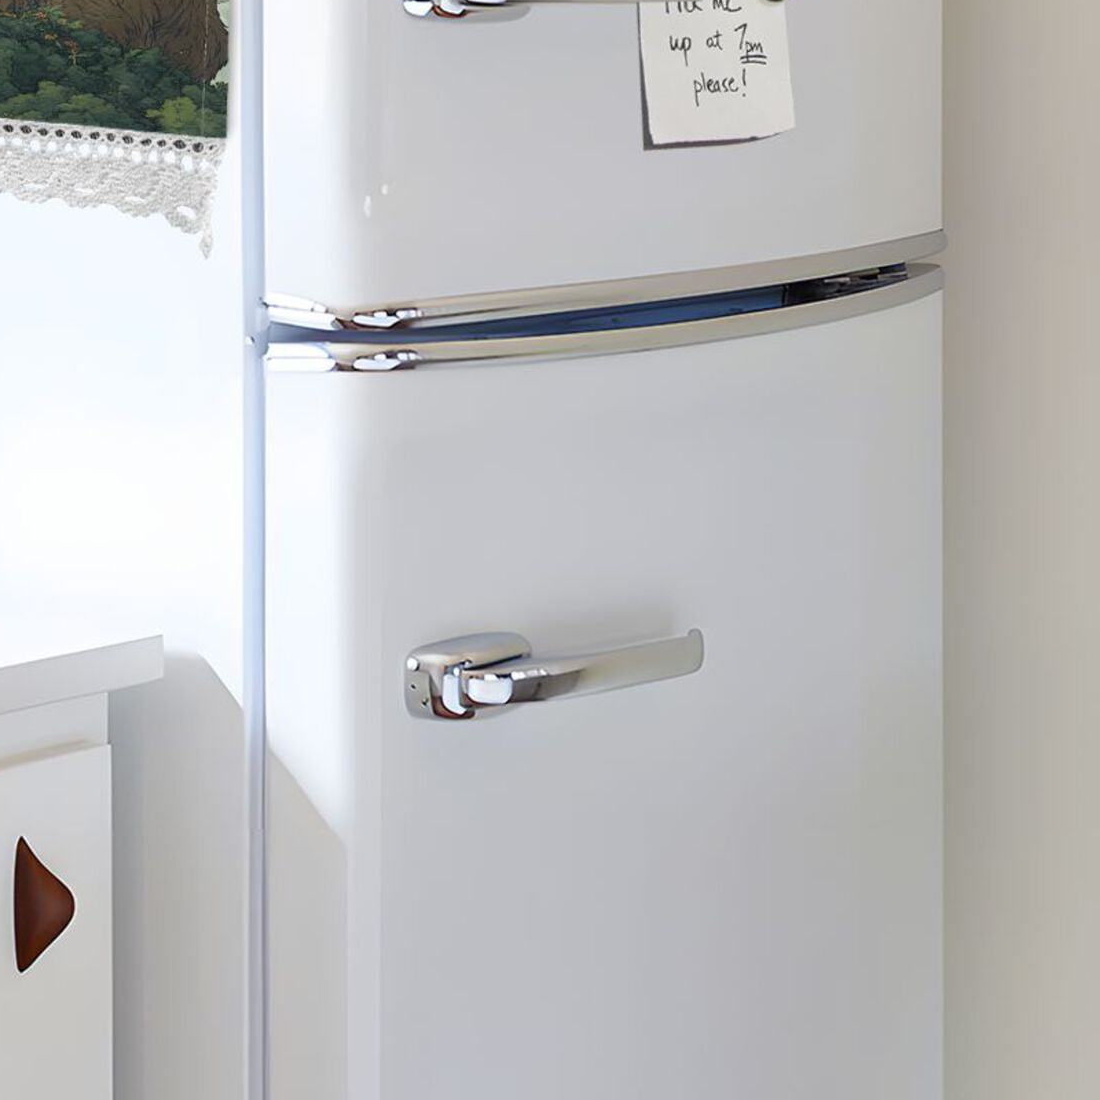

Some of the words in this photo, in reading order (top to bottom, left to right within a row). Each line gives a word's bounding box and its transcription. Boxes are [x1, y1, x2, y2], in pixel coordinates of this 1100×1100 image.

[669, 35, 692, 67] up
[706, 30, 723, 51] at
[693, 68, 747, 107] please!
